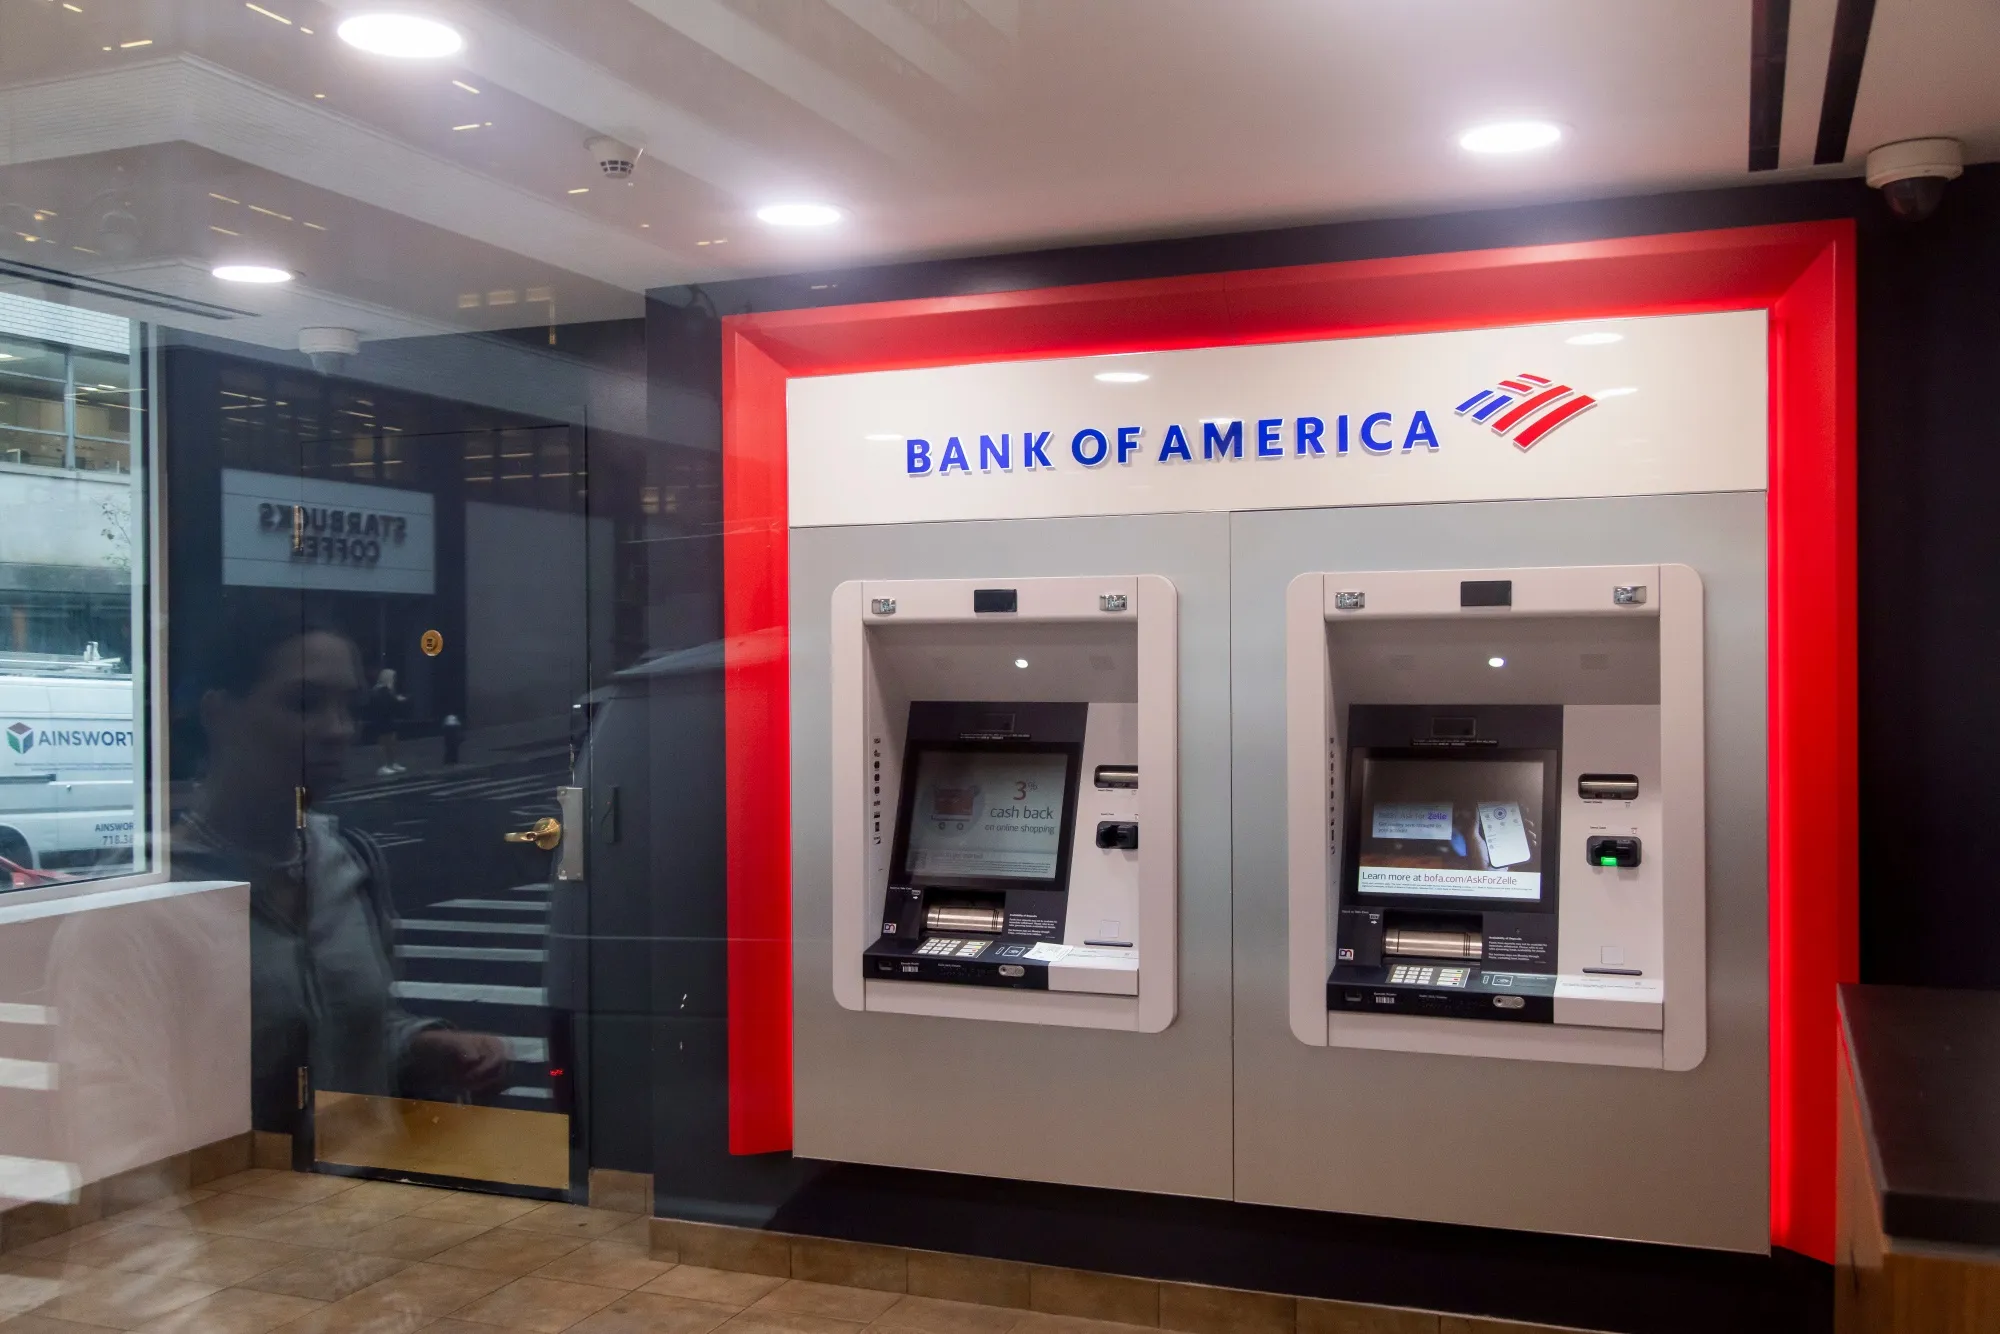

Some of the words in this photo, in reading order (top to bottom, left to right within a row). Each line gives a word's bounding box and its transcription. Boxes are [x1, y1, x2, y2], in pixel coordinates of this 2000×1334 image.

[907, 431, 1055, 475] BANK
[1071, 426, 1142, 466] OF
[1157, 410, 1441, 463] AMERICA
[990, 805, 1020, 819] cash
[1023, 805, 1054, 820] back
[996, 824, 1019, 832] online
[1020, 824, 1055, 834] shopping
[1362, 871, 1387, 881] Learn
[1388, 874, 1411, 882] more
[1413, 874, 1422, 882] at
[1423, 873, 1518, 886] bofa.com/AskForZelle
